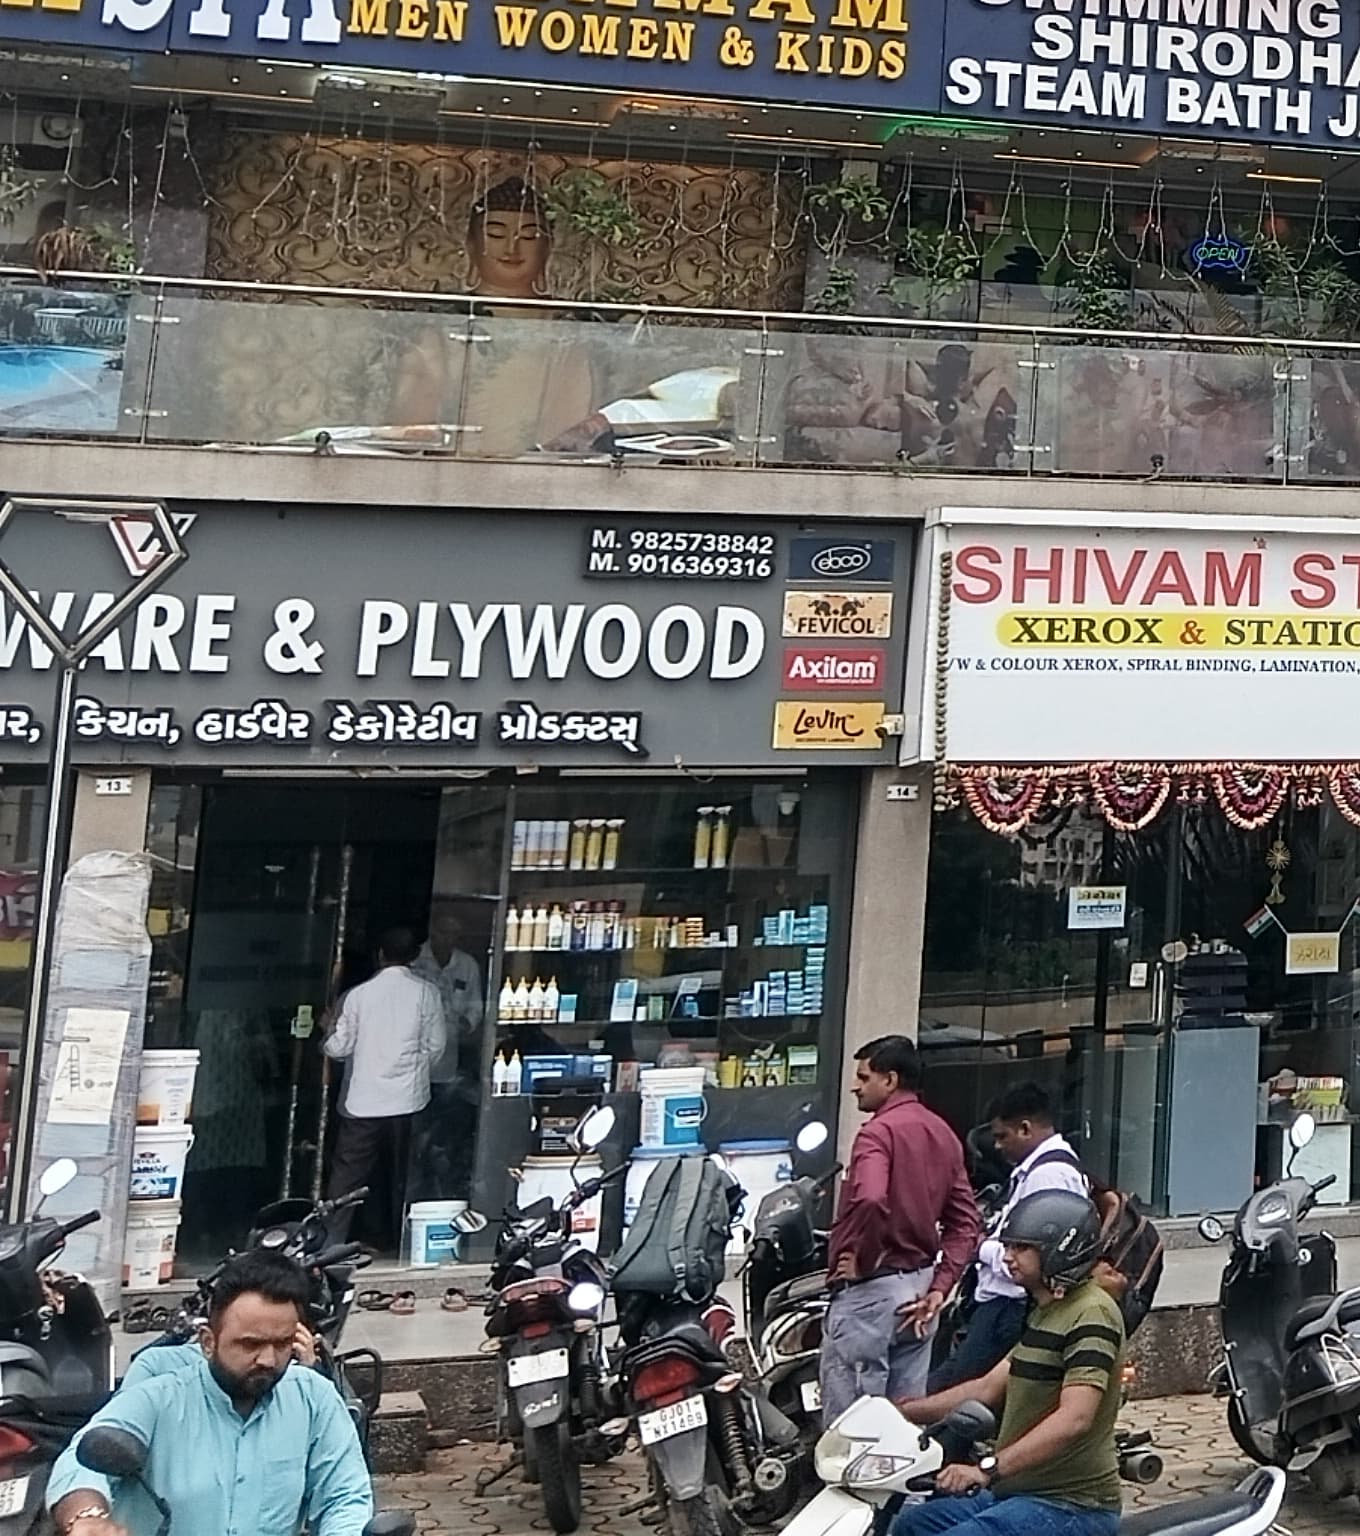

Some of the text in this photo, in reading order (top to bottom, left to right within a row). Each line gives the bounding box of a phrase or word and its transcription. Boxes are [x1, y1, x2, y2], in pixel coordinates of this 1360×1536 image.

[495, 8, 690, 62] WOMEN
[720, 28, 755, 68] &
[776, 32, 907, 80] KIDS
[945, 57, 1146, 120] STEAM
[1166, 78, 1311, 134] BATH
[1196, 241, 1243, 265] OPEN
[591, 530, 774, 556] M. 9825738842
[589, 553, 772, 578] M. 9016369316
[953, 545, 1264, 608] SHIVAM
[264, 598, 325, 675] &
[356, 600, 766, 681] PLYWOOD
[797, 617, 875, 635] FEVICOL
[1011, 615, 1163, 645] XEROX
[1178, 620, 1206, 646] &
[788, 655, 876, 681] Axilam
[990, 657, 1059, 672] COLOUR
[1127, 659, 1182, 673] SPIRAL
[328, 703, 478, 742] ડેકોરેટીવ
